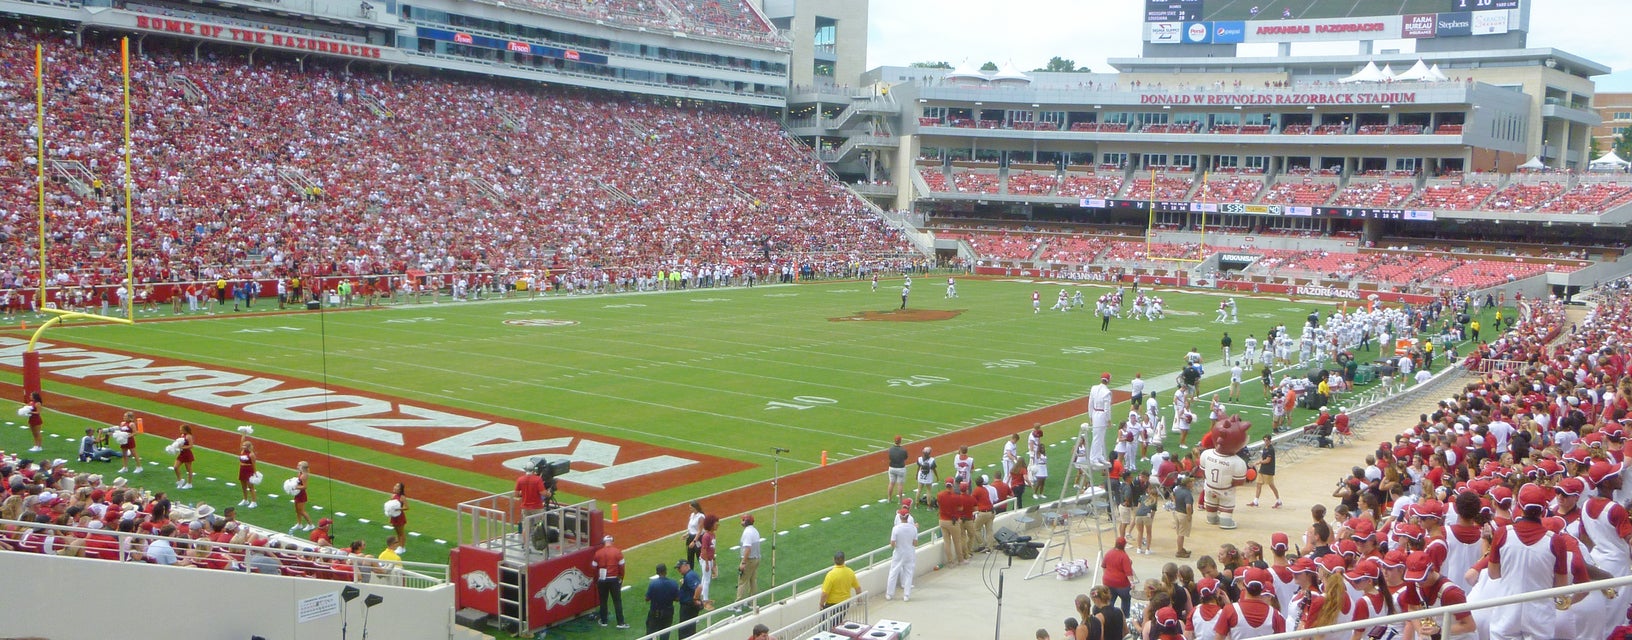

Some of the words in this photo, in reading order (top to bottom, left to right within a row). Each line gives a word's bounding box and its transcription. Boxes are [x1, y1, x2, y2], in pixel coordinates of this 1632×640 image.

[1256, 25, 1310, 35] ARKANSAS
[1315, 22, 1384, 33] RAZORBACKS
[1405, 22, 1432, 30] BUREAU
[1438, 20, 1469, 29] Stephens
[137, 15, 195, 35] HOME
[200, 24, 223, 38] OF
[230, 28, 266, 44] THE
[272, 33, 381, 58] RAZORBACKS
[457, 34, 471, 44] Tyson
[511, 42, 529, 53] Tyson
[1140, 94, 1190, 104] DONALD
[1193, 94, 1206, 104] W
[1207, 94, 1272, 104] REYNOLDS
[1275, 93, 1352, 104] RAZORBACK
[1357, 92, 1416, 103] STADIUM
[1296, 286, 1360, 299] RAZORACKS
[886, 374, 950, 388] 20
[764, 395, 838, 410] 10
[0, 336, 699, 488] RAZORBACK
[1211, 468, 1219, 483] 1
